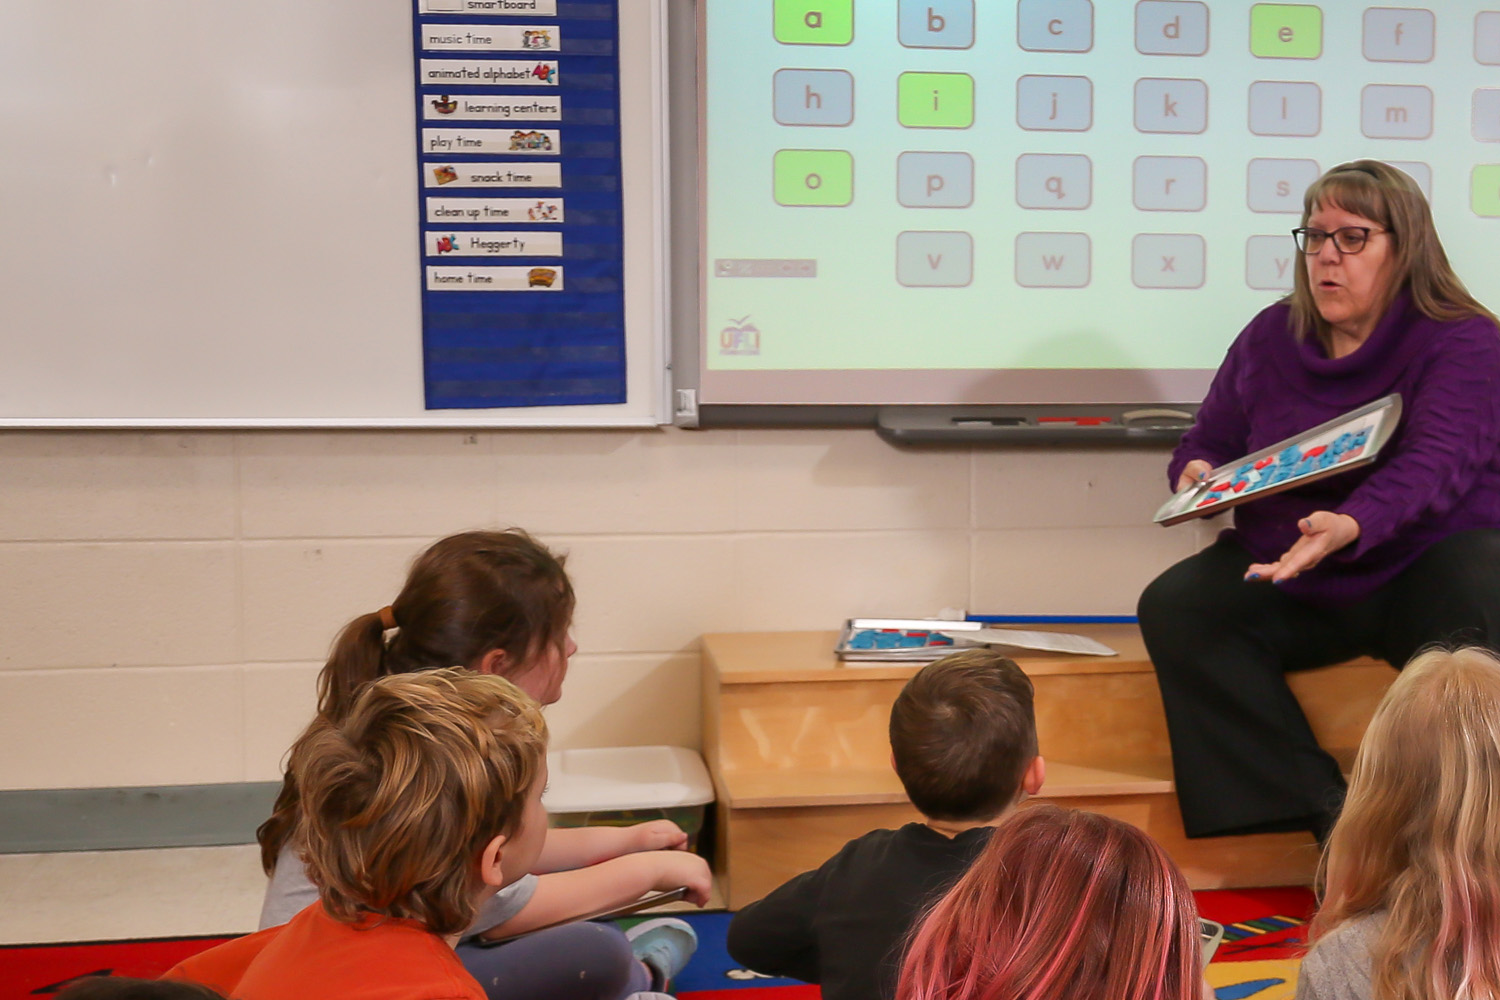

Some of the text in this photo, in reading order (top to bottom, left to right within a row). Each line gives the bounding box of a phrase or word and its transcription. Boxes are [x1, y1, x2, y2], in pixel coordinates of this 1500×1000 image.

[467, 0, 536, 9] smartboard
[803, 10, 823, 30] a
[926, 6, 947, 34] b
[1046, 17, 1064, 37] c
[1161, 14, 1181, 40] d
[1276, 25, 1295, 44] e
[1393, 21, 1405, 47] f
[429, 32, 492, 44] music time
[428, 67, 480, 78] animated
[483, 67, 531, 83] alphabet
[465, 101, 557, 117] learning centers
[804, 83, 823, 110] h
[931, 87, 941, 113] i
[1046, 91, 1059, 122] j
[1162, 92, 1179, 119] k
[1384, 105, 1409, 124] m
[430, 136, 482, 150] play time
[470, 170, 532, 182] snack time
[803, 171, 823, 191] o
[925, 173, 946, 199] p
[1043, 175, 1067, 201] q
[1163, 177, 1178, 198] r
[1275, 179, 1292, 199] s
[434, 205, 509, 220] clean up time
[470, 237, 526, 253] Heggerty
[926, 252, 1290, 281] v w x y
[434, 272, 493, 283] home time
